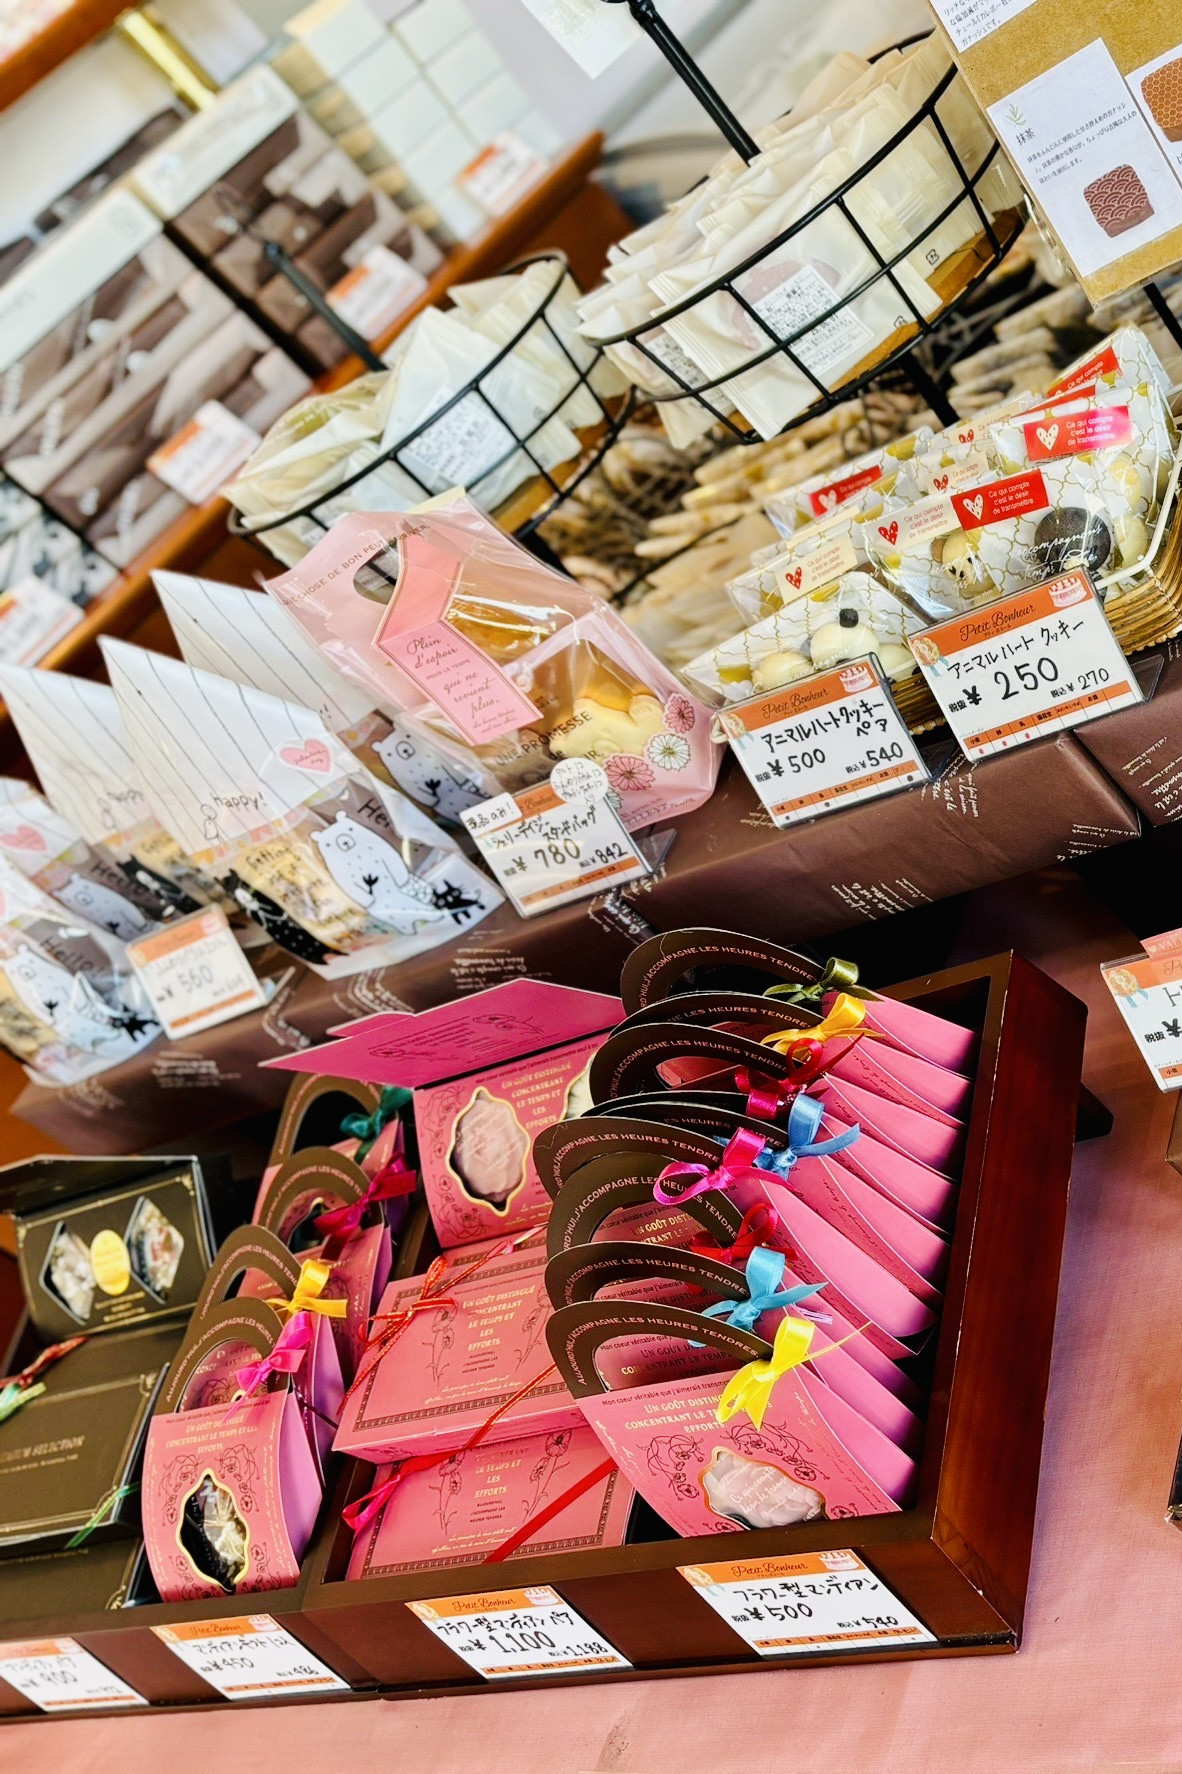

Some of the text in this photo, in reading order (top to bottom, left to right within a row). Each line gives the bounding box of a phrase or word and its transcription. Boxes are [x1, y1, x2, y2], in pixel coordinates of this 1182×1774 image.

[1016, 128, 1036, 146] 抹茶
[298, 578, 328, 602] CHOSE
[328, 568, 342, 581] DE
[342, 553, 364, 570] BON
[960, 604, 1037, 642] Petit Bonheur
[406, 635, 442, 656] Plein
[947, 619, 1086, 680] アニマルハート クッキー
[762, 688, 829, 719] Petit Bonheur
[948, 700, 967, 714] 税抜
[522, 710, 594, 755] PROMESSE
[761, 699, 885, 754] アニマルハートクッキー
[856, 717, 889, 738] ペア
[731, 1561, 808, 1578] Petit Bonheur
[452, 1597, 517, 1612] Petit Bonheur
